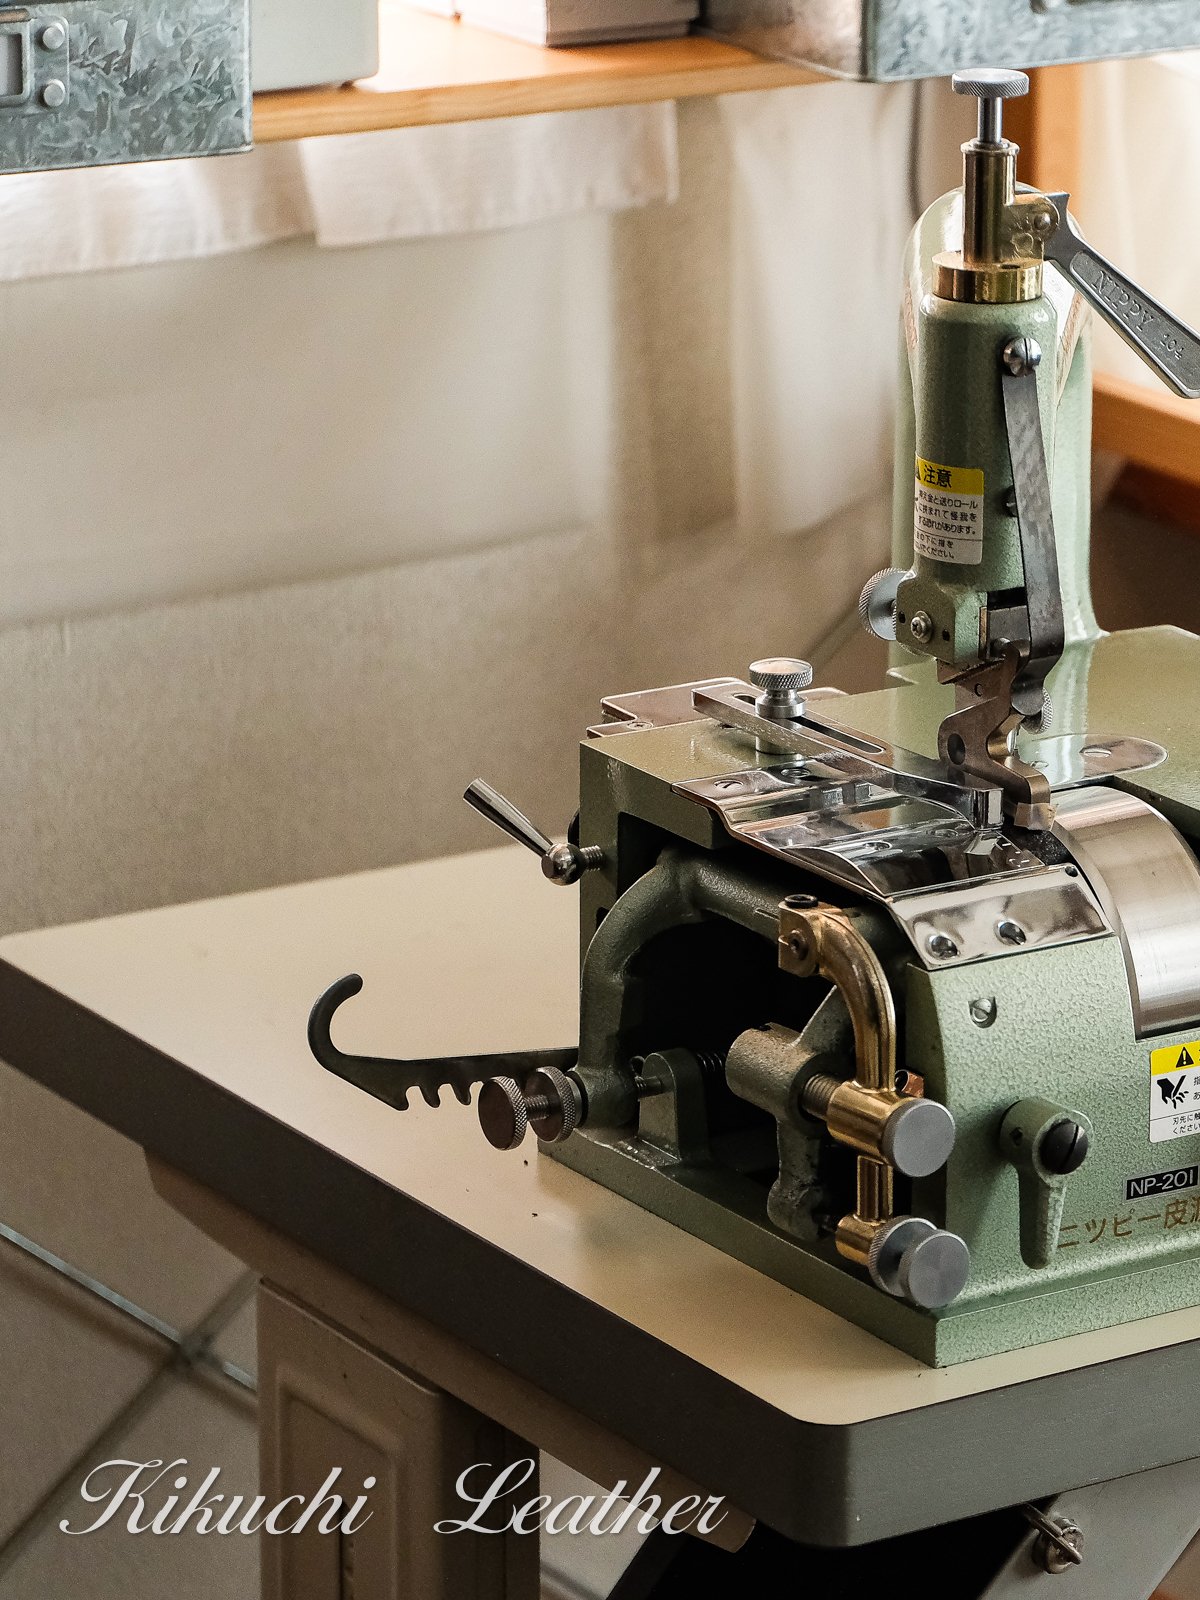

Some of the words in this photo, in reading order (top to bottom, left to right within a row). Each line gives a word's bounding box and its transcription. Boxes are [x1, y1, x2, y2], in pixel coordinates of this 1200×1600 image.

[1092, 270, 1154, 331] NIPPY
[924, 464, 952, 488] 注意
[1130, 1169, 1194, 1197] NP-201
